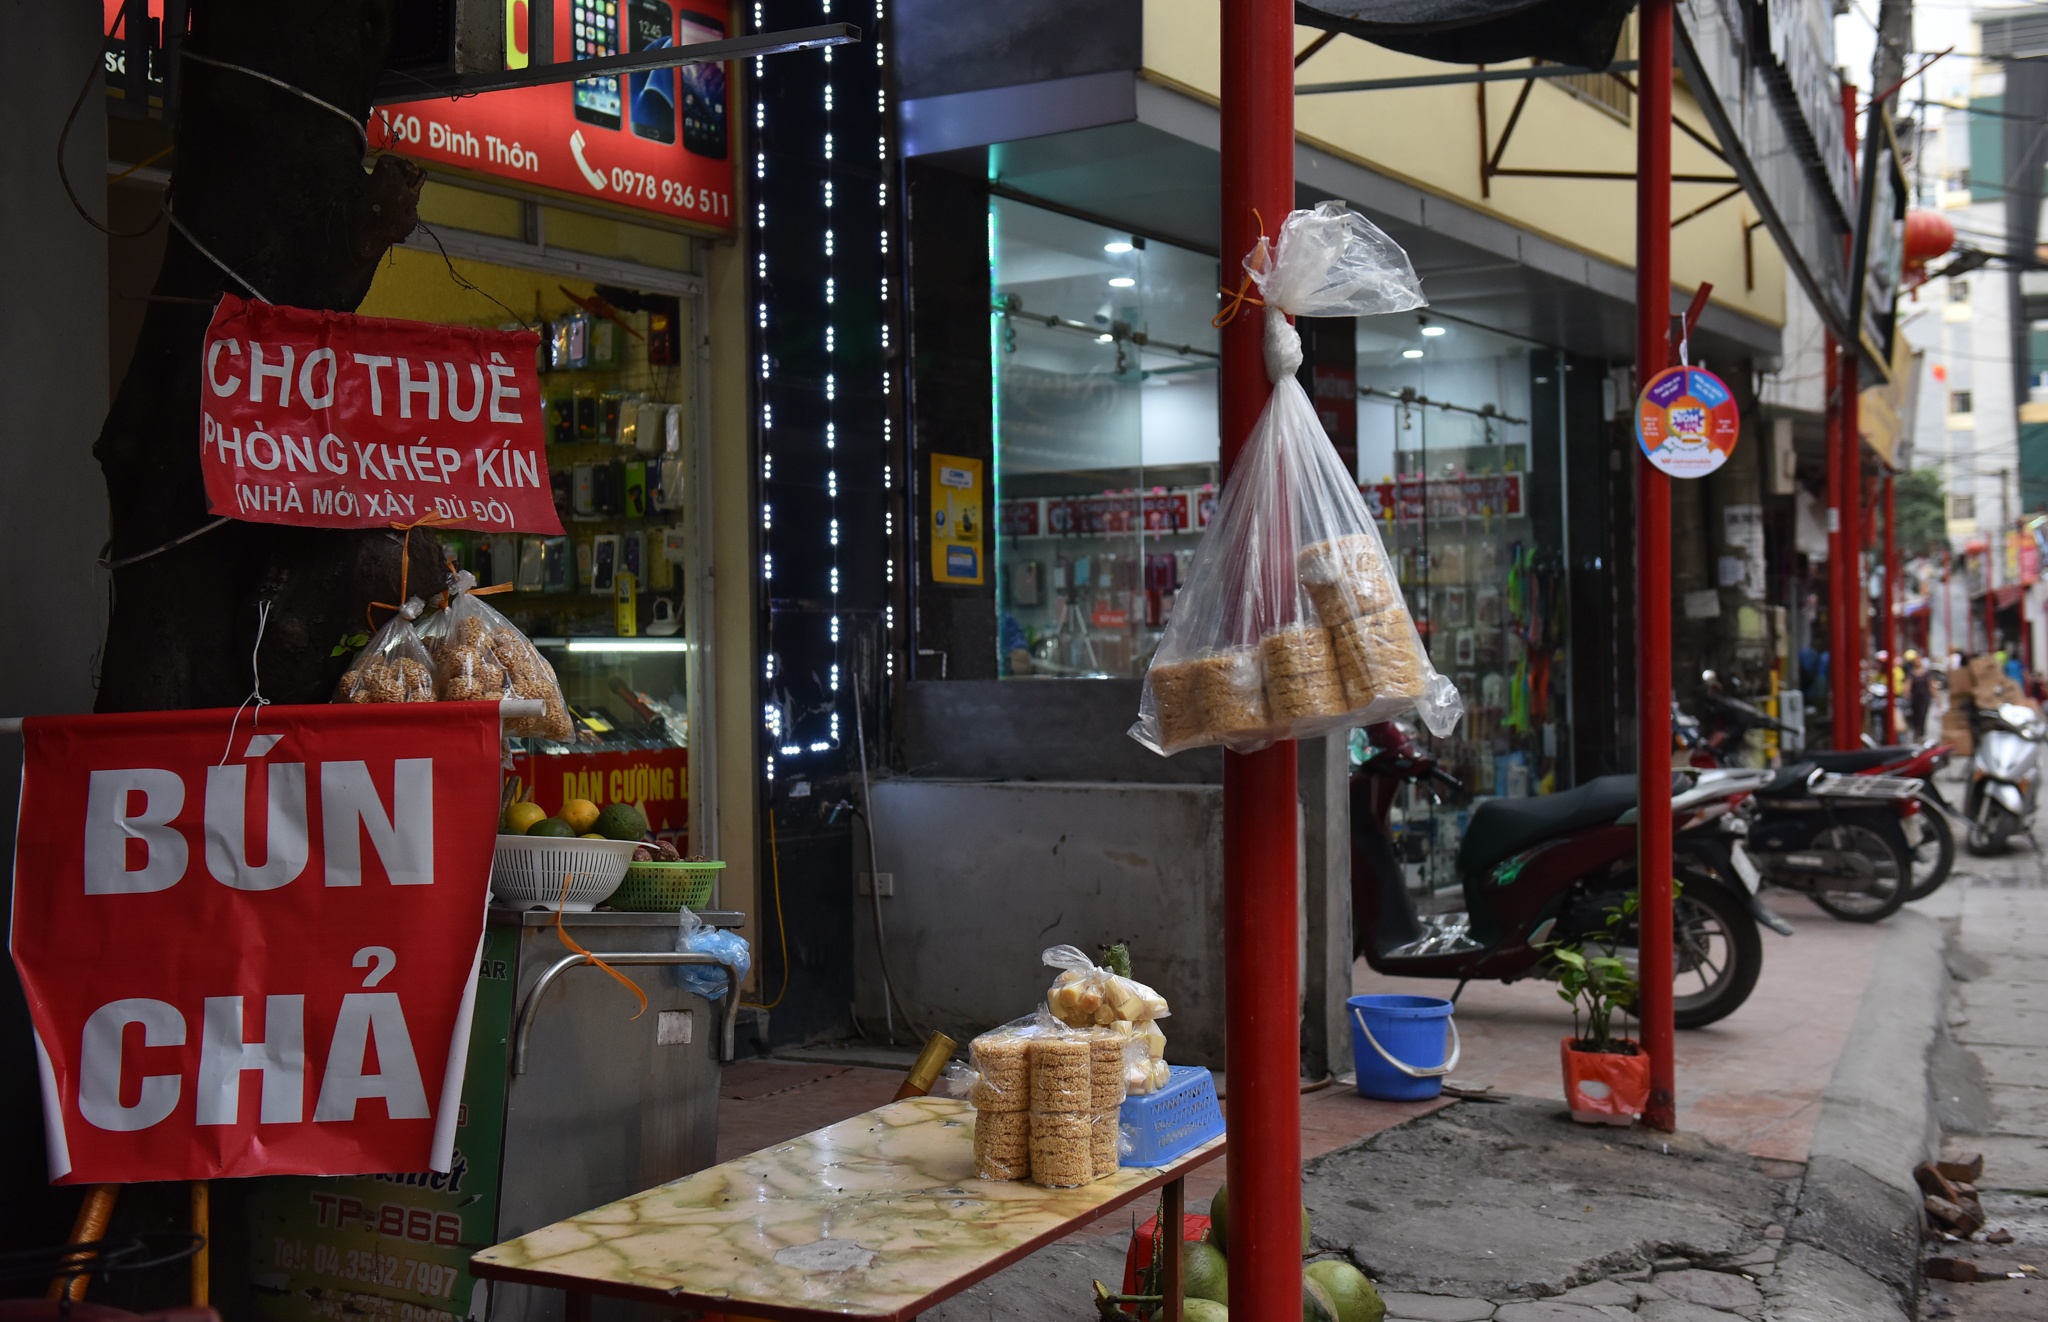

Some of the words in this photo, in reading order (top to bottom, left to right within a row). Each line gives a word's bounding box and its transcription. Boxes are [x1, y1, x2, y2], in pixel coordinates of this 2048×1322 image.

[381, 109, 421, 144] 160
[429, 122, 480, 159] Đình
[486, 135, 538, 173] Thôn
[611, 167, 657, 200] 0978
[662, 179, 695, 209] 936
[699, 189, 729, 217] 511
[207, 338, 337, 410] CHO
[354, 352, 523, 423] THUÊ
[204, 412, 348, 475] PHÒNG
[353, 437, 461, 484] KHÉP
[475, 440, 540, 488] KÍN
[235, 482, 304, 514] (NHÀ
[312, 485, 361, 517] MỚI
[364, 489, 416, 517] XÂY
[436, 494, 464, 519] ĐỦ
[563, 765, 603, 804] DÁN
[610, 763, 674, 803] CƯỜNG
[84, 734, 434, 895] BÚN
[78, 946, 431, 1131] CHẢ
[311, 1191, 461, 1247] TP-866
[273, 1236, 307, 1271] Tel:
